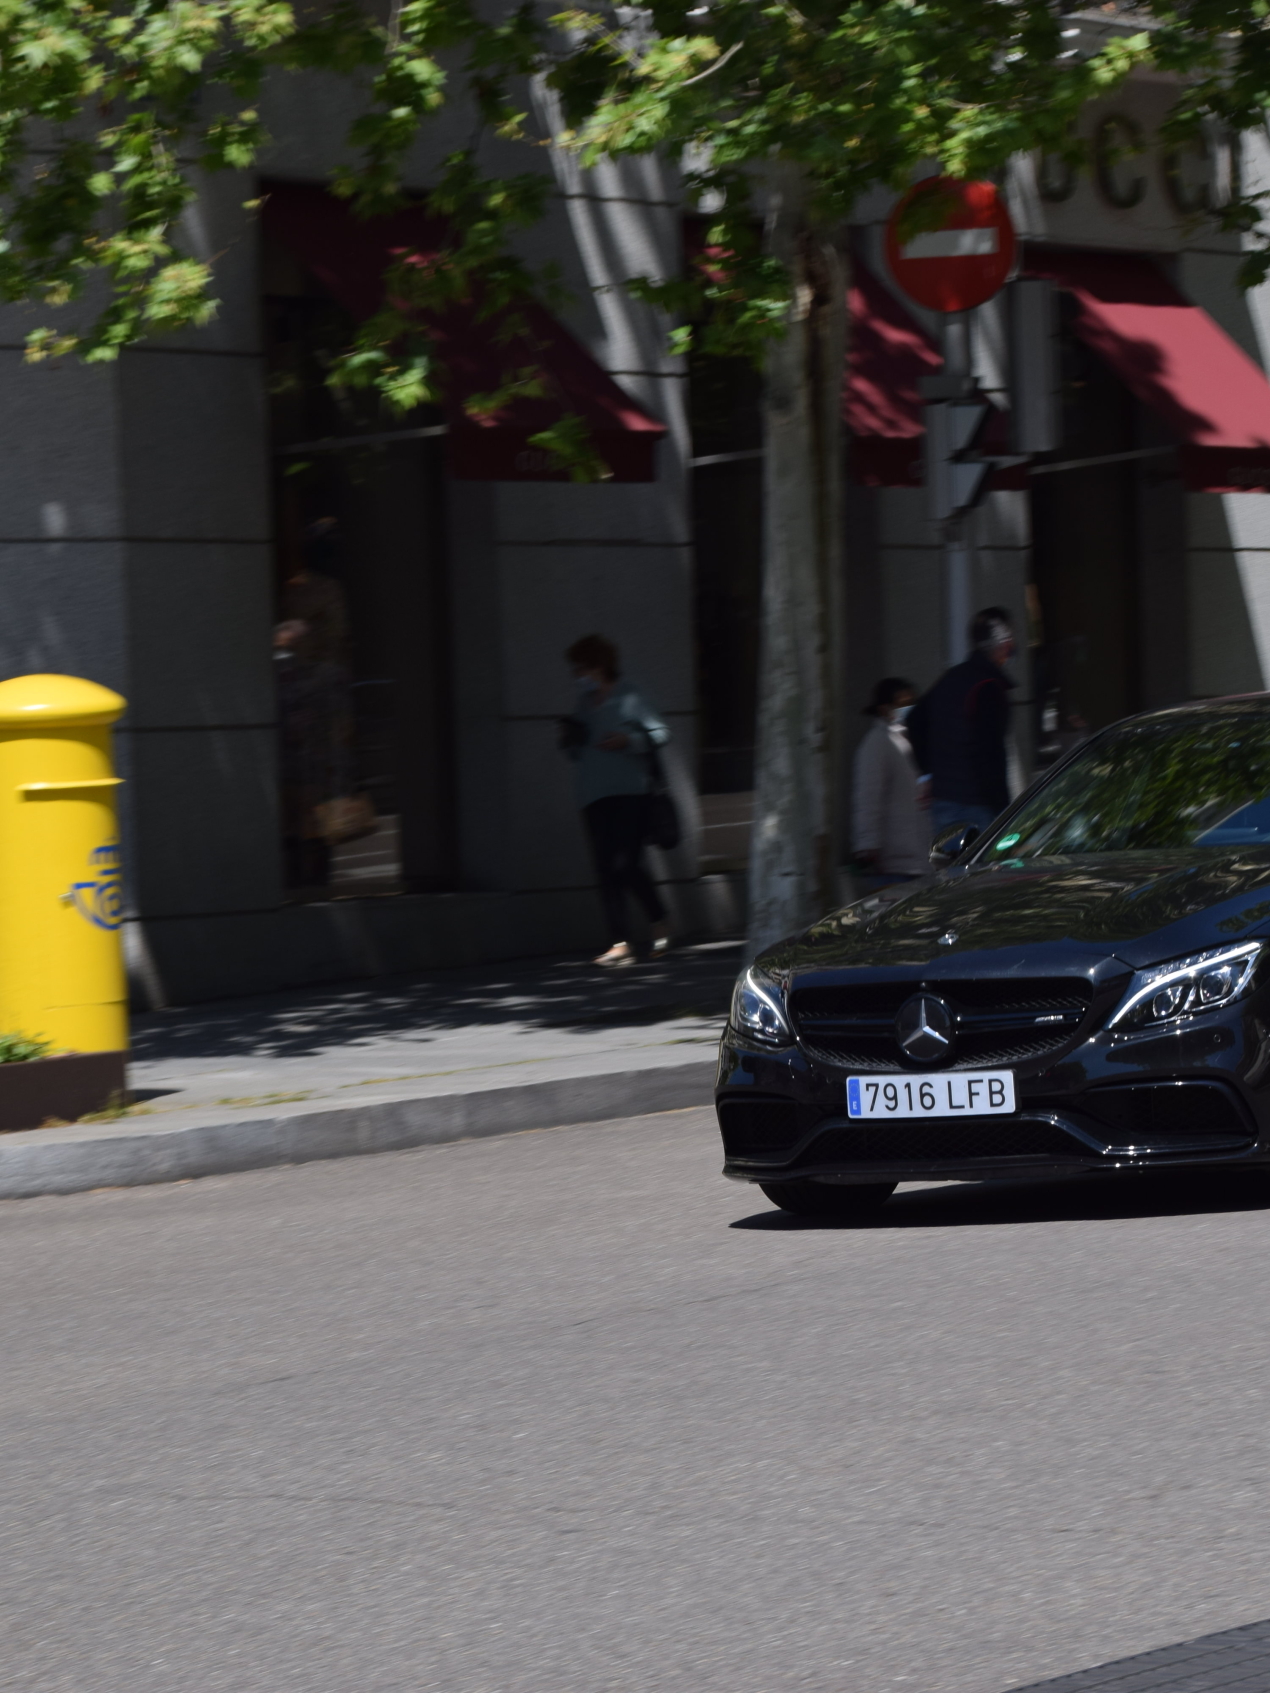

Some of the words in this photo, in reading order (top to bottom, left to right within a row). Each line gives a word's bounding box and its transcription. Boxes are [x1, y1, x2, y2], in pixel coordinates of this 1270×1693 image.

[852, 1100, 858, 1111] E
[865, 1081, 936, 1112] 7916
[947, 1078, 1006, 1110] LFB
